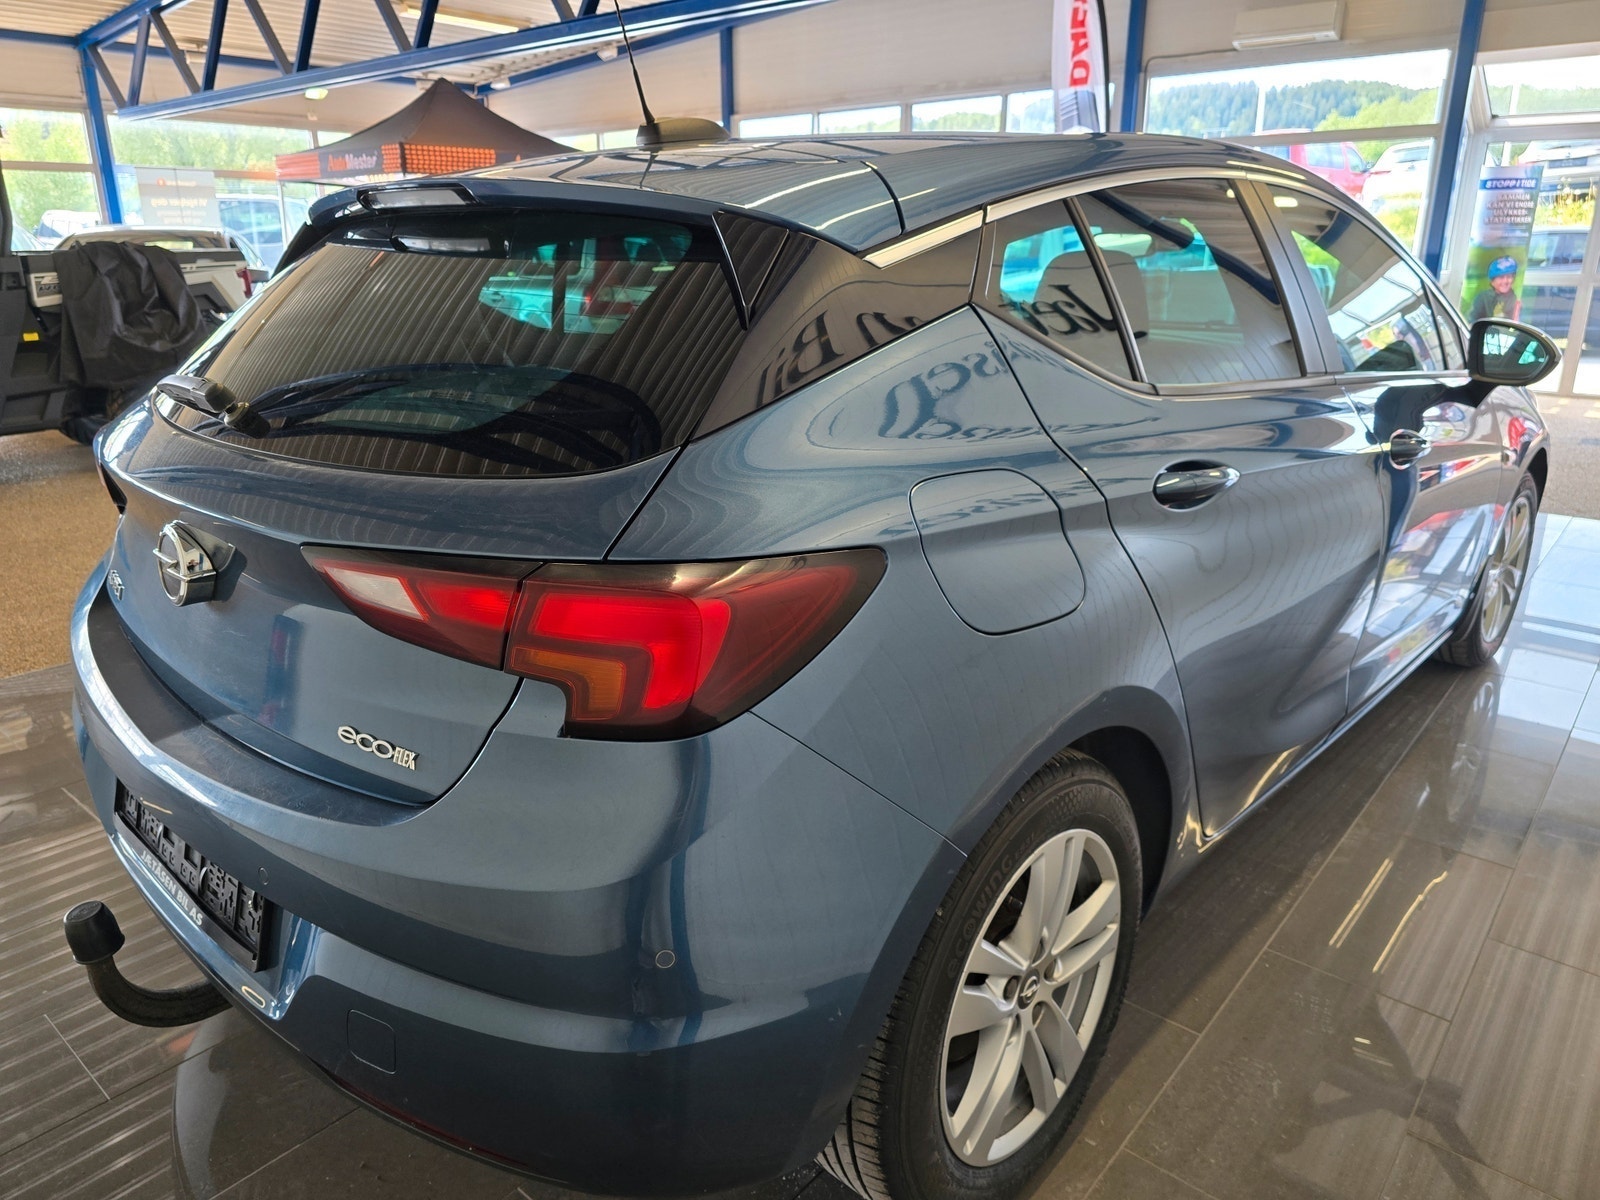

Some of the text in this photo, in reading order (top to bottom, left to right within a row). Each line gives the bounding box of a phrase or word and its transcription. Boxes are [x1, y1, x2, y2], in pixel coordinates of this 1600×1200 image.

[1485, 179, 1516, 189] STOPP
[1521, 178, 1537, 188] TIDE
[141, 850, 204, 926] JÆTÅSEN BIL AS
